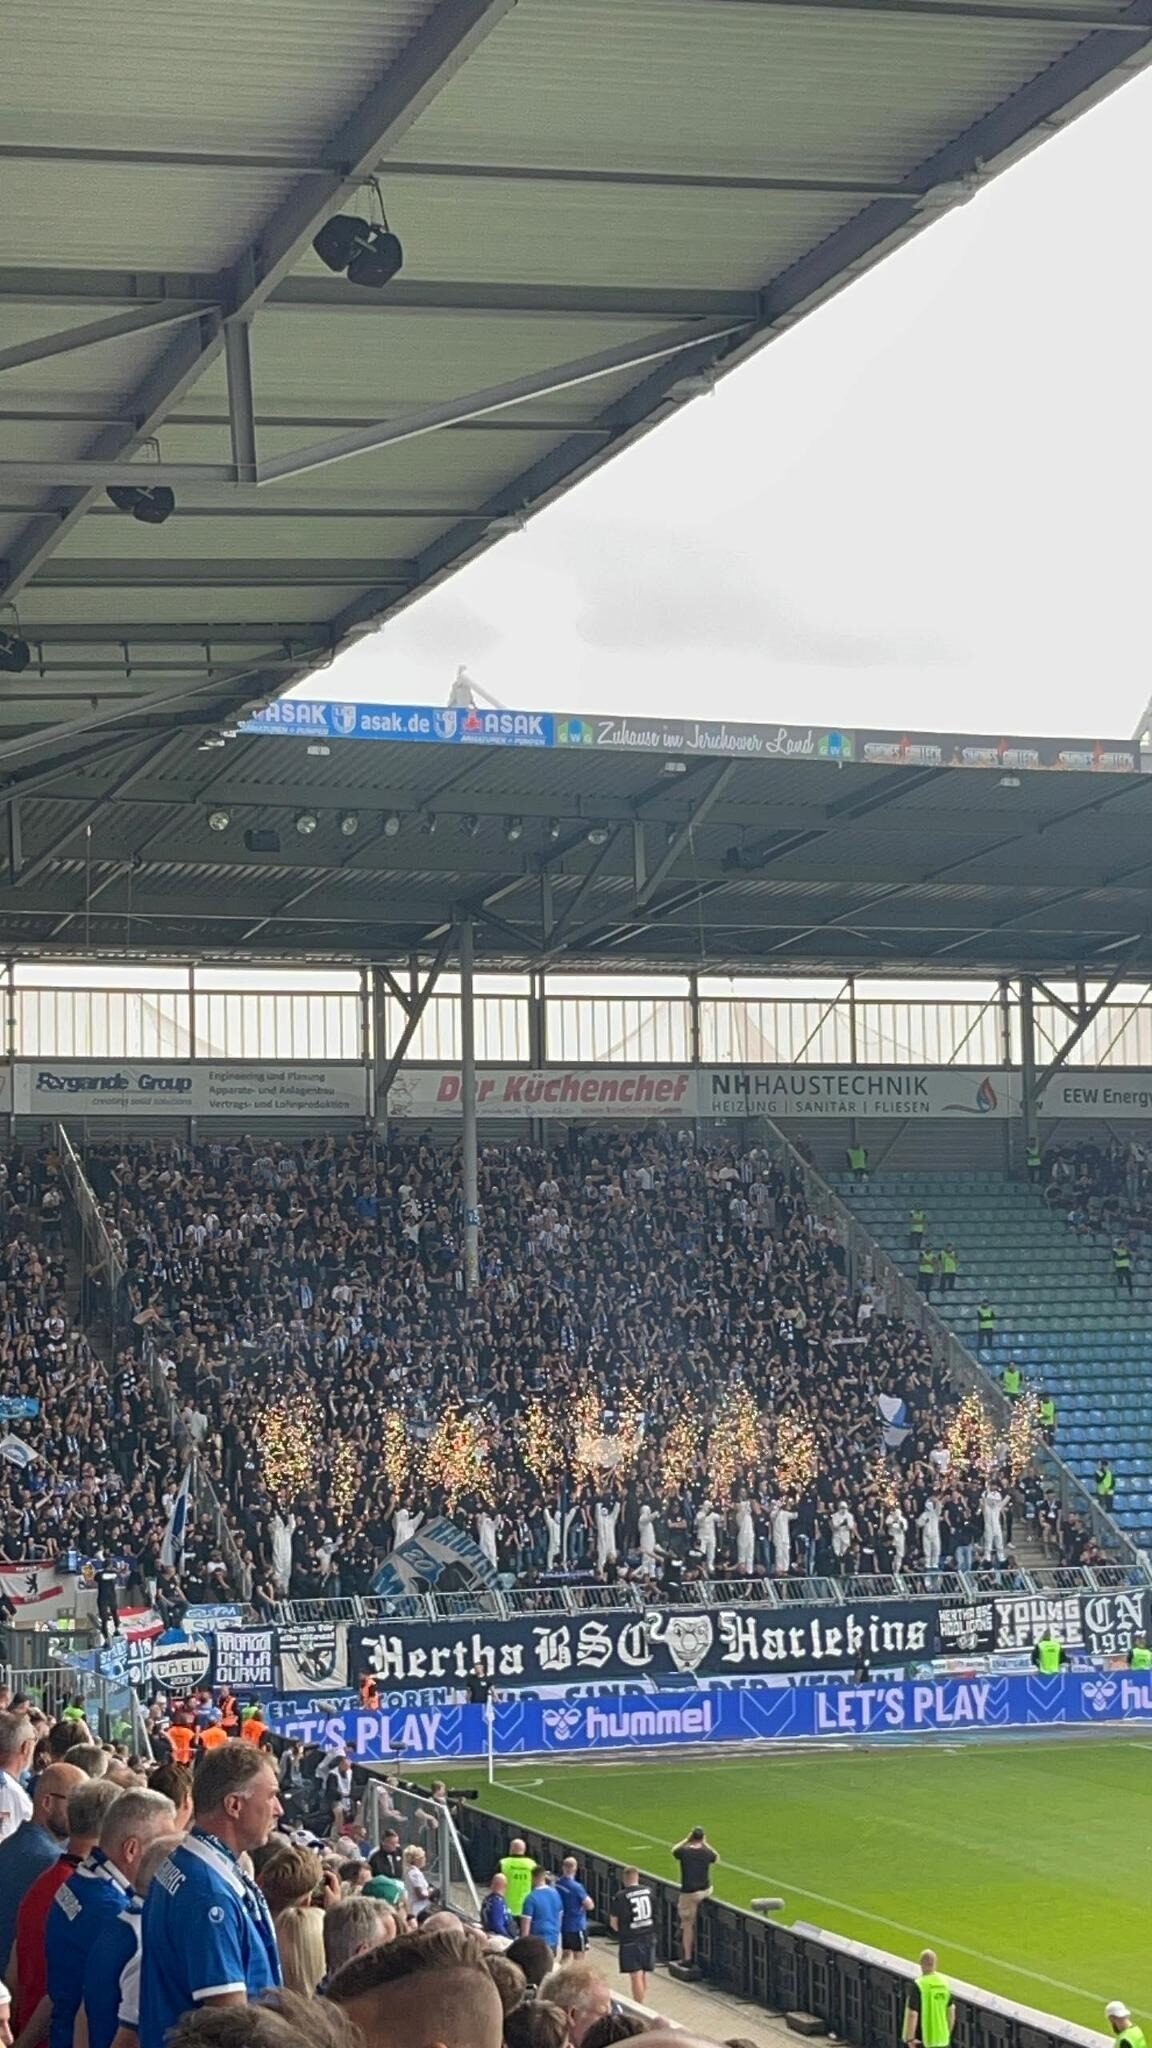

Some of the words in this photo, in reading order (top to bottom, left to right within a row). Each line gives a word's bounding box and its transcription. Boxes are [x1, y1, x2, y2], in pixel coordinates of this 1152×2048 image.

[361, 712, 430, 733] asak.de
[484, 714, 544, 736] ASAK
[597, 720, 660, 746] Zuhause
[686, 724, 762, 753] Jerichower
[766, 728, 814, 756] Land
[138, 1073, 193, 1093] Group
[267, 1072, 285, 1081] und
[436, 1076, 496, 1102] Dr
[502, 1073, 689, 1103] Küchenchef
[259, 1086, 277, 1095] und
[1063, 1088, 1099, 1103] EEW
[254, 1100, 273, 1109] und
[711, 1101, 777, 1112] HEIZUNG
[875, 1101, 930, 1113] FLIESEN
[996, 1599, 1081, 1625] YOUNG
[361, 1634, 525, 1680] Hertha
[532, 1620, 654, 1671] BSC
[722, 1613, 928, 1663] Harlekins
[217, 1651, 271, 1667] DELLA
[817, 1687, 905, 1728] LET'S
[914, 1682, 991, 1723] PLAY
[586, 1700, 711, 1740] hummel
[356, 1713, 442, 1755] PLAY
[630, 1895, 652, 1922] 30
